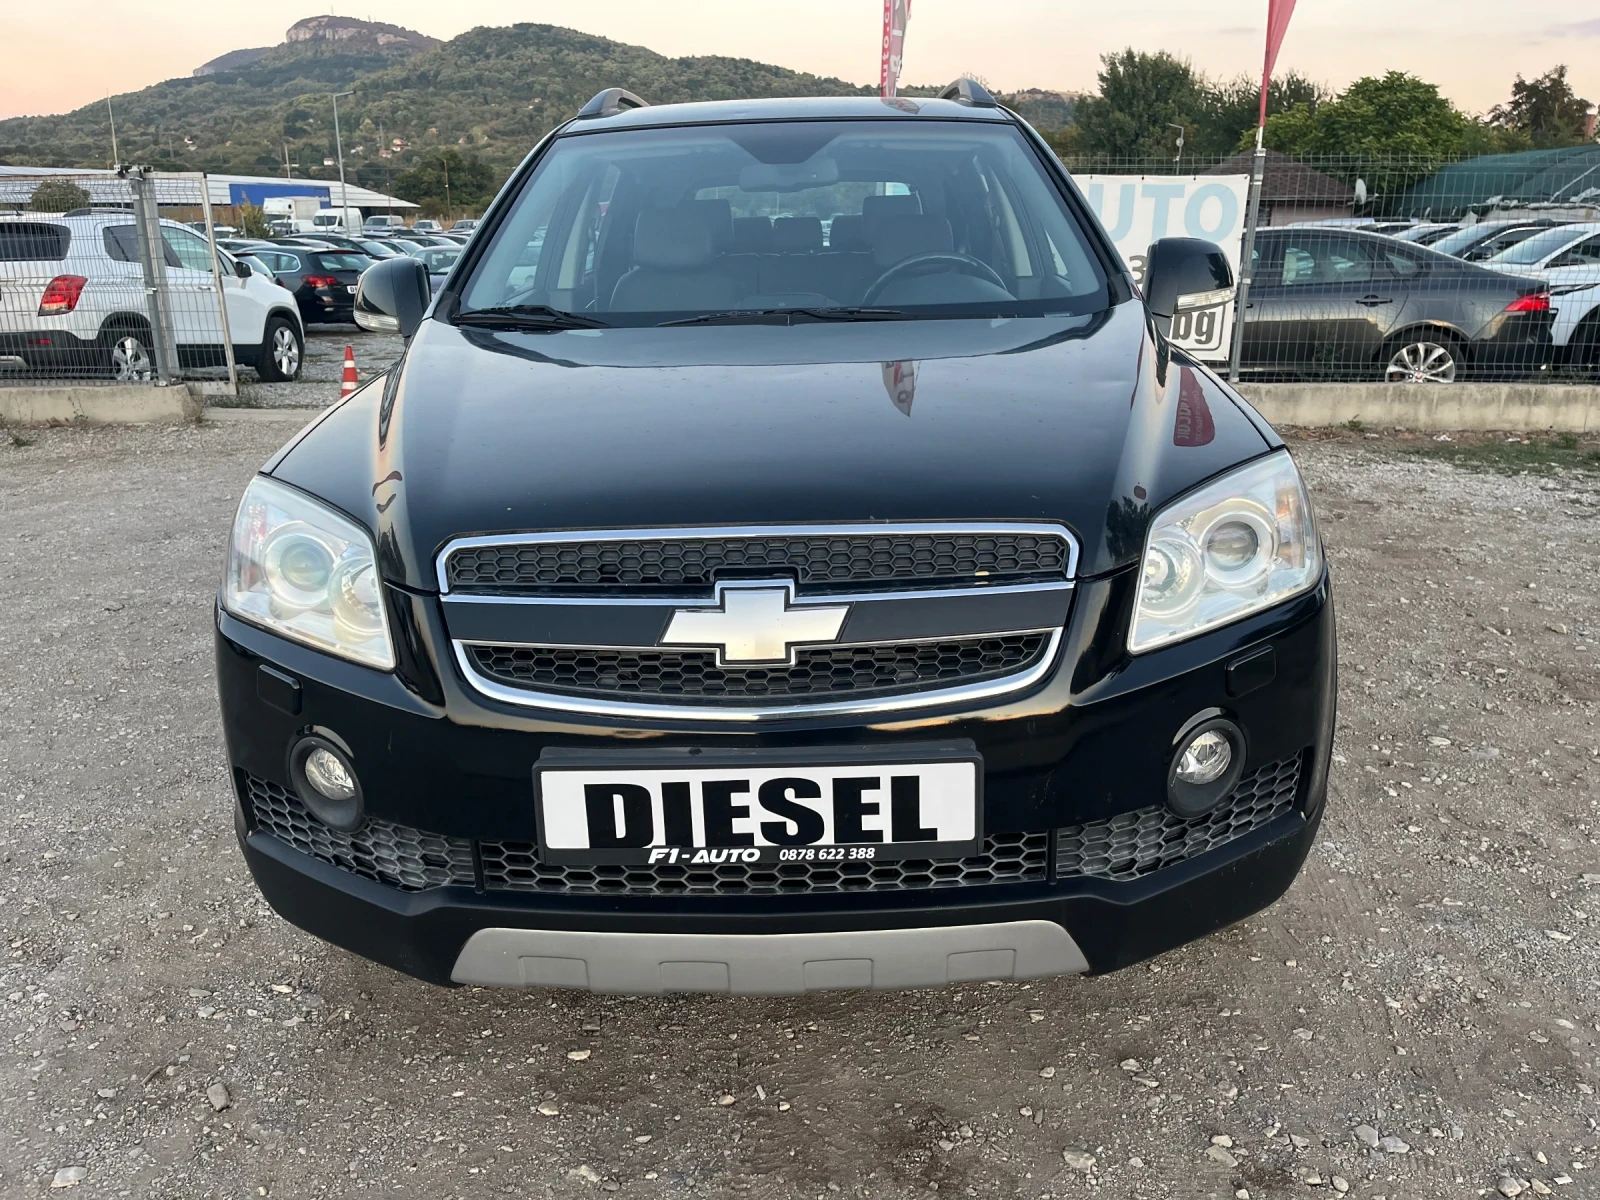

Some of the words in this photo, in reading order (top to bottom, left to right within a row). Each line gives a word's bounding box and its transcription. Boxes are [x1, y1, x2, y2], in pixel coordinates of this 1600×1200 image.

[583, 776, 939, 849] DIESEL
[647, 847, 761, 864] F1-AUTO
[779, 848, 816, 861] 0878
[818, 847, 845, 860] 622
[848, 847, 876, 859] 388
